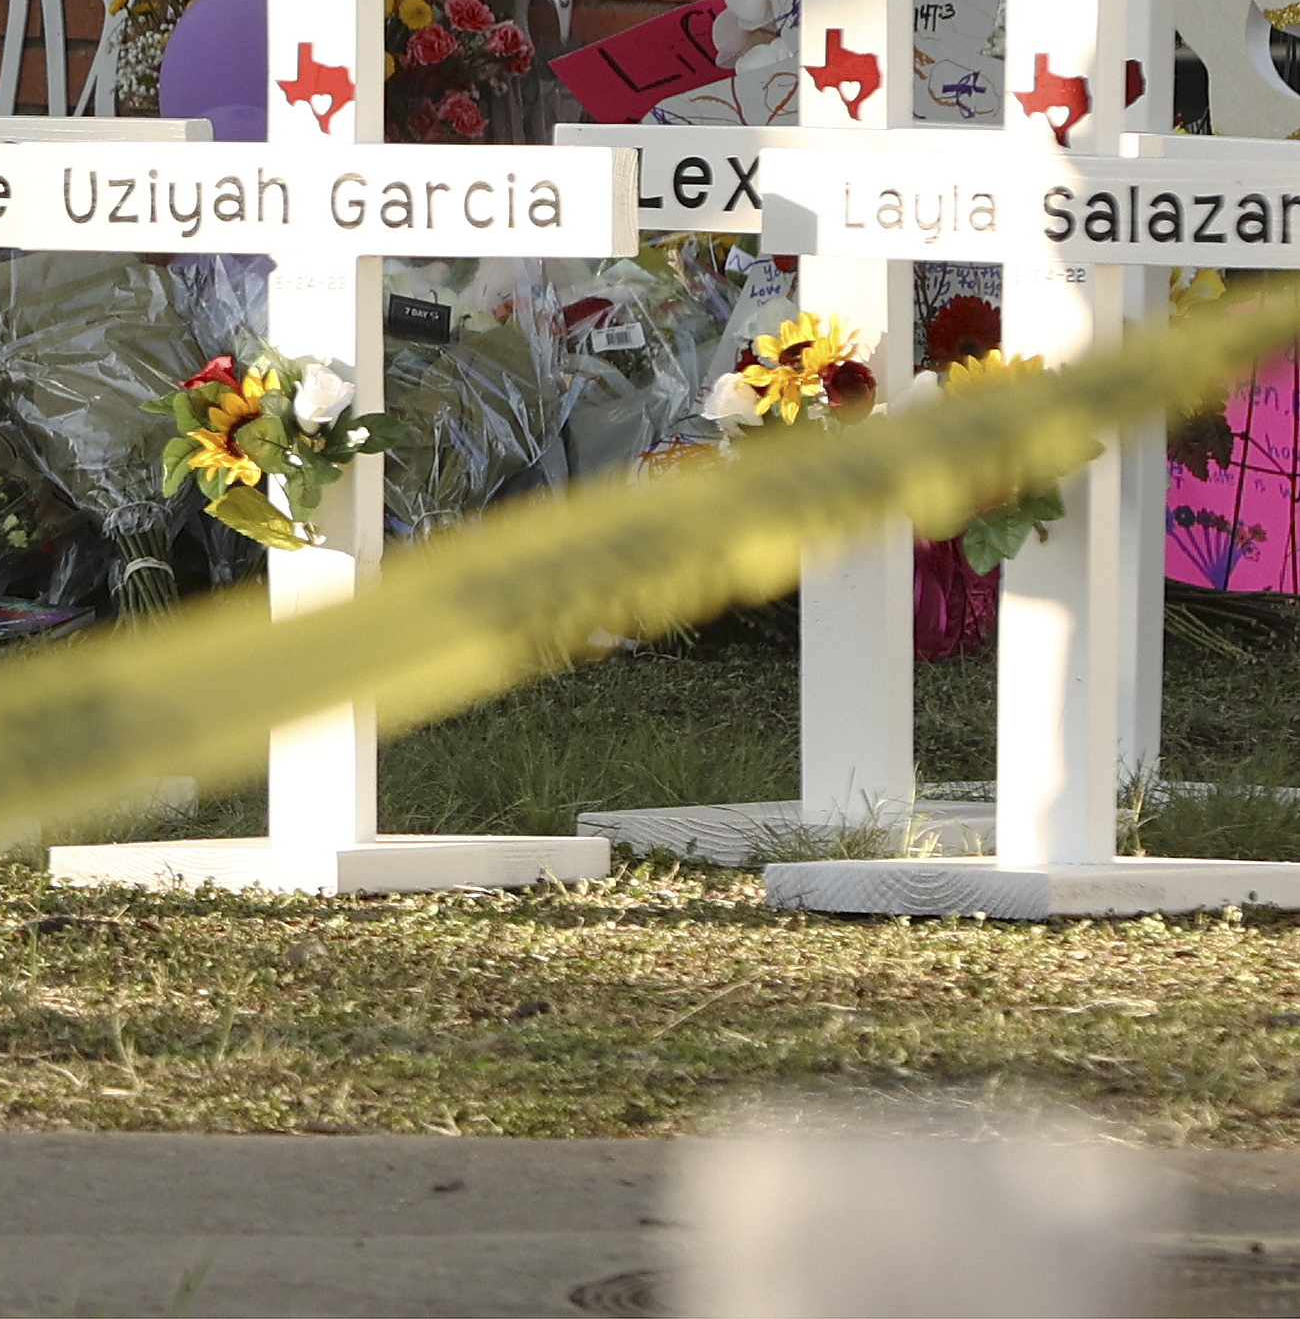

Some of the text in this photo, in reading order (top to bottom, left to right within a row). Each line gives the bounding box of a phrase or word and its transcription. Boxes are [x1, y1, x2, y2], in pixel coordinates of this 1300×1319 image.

[63, 167, 562, 238] Uziyah Garcia
[844, 181, 1300, 245] Layla Salazar
